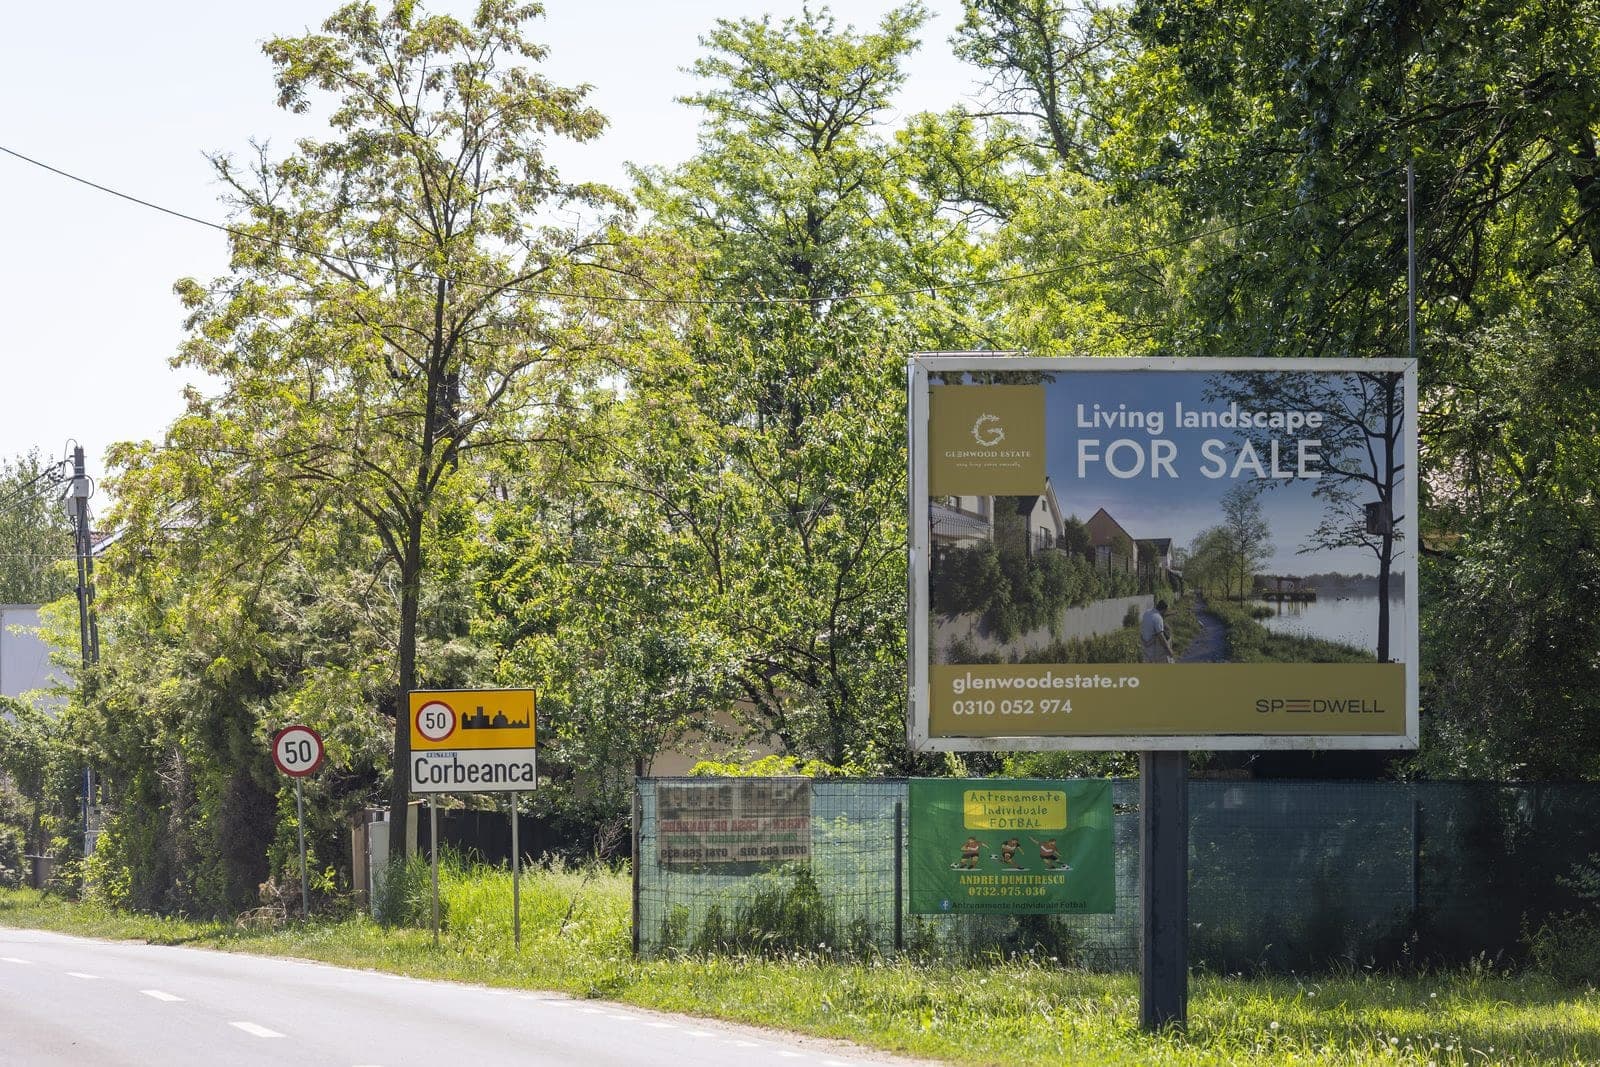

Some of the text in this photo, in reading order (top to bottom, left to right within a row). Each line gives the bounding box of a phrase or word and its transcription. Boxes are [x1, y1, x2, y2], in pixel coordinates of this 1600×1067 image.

[1076, 401, 1323, 435] Living landscape
[945, 450, 1032, 458] GLENWOOD ESTATE
[1077, 438, 1323, 479] FOR SALE
[952, 671, 1140, 695] glenwoodestate.ro
[952, 699, 1073, 715] 0310 052 974
[425, 712, 447, 730] 50
[284, 740, 312, 765] 50
[414, 755, 534, 785] Corbeanca
[970, 791, 1060, 802] Antrenamente
[983, 804, 1049, 815] Individuale
[990, 817, 1042, 829] FOTBAL
[959, 874, 1065, 885] ANDREI DUMITRESCU
[968, 886, 1047, 896] 0732.975.036
